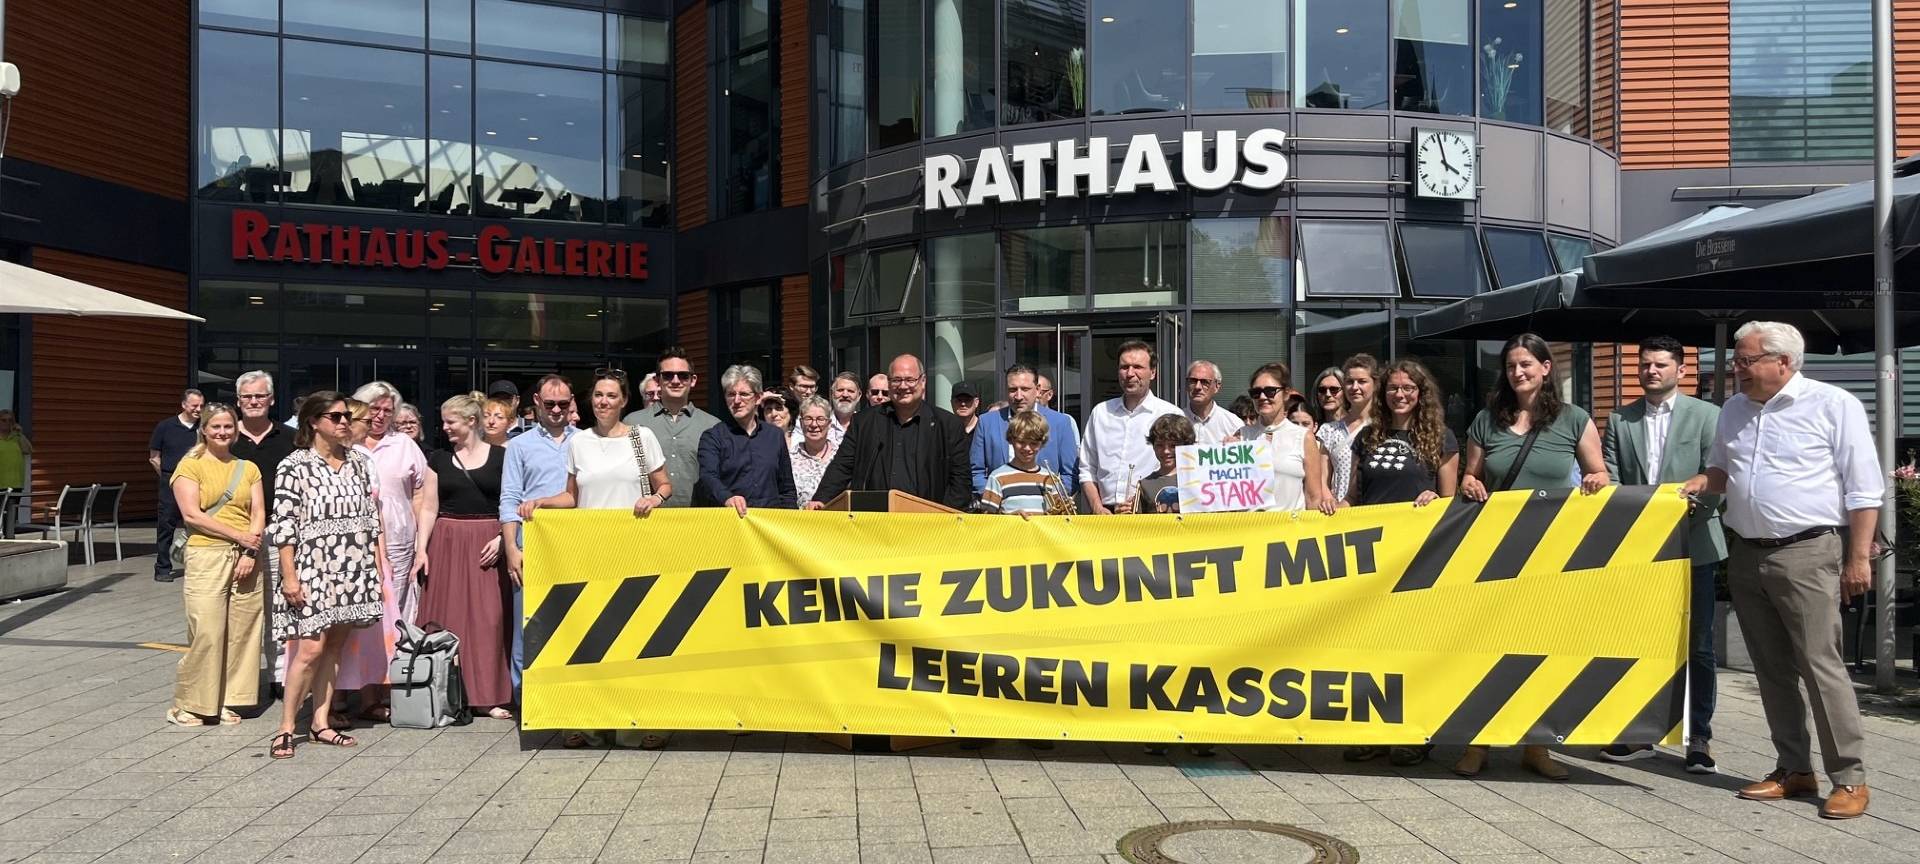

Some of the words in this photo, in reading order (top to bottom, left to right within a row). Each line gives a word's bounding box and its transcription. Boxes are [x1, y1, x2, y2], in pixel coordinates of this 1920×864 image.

[924, 128, 1289, 211] RATHAUS
[1696, 240, 1706, 258] Die
[1197, 445, 1255, 466] MUSIK
[1209, 466, 1251, 480] MACHT
[1201, 480, 1267, 507] STARK
[743, 572, 922, 628] KEINE
[940, 546, 1244, 616] ZUKUNFT
[1265, 526, 1384, 589] MIT
[877, 642, 1109, 708] LEEREN
[1130, 663, 1404, 724] KASSEN
